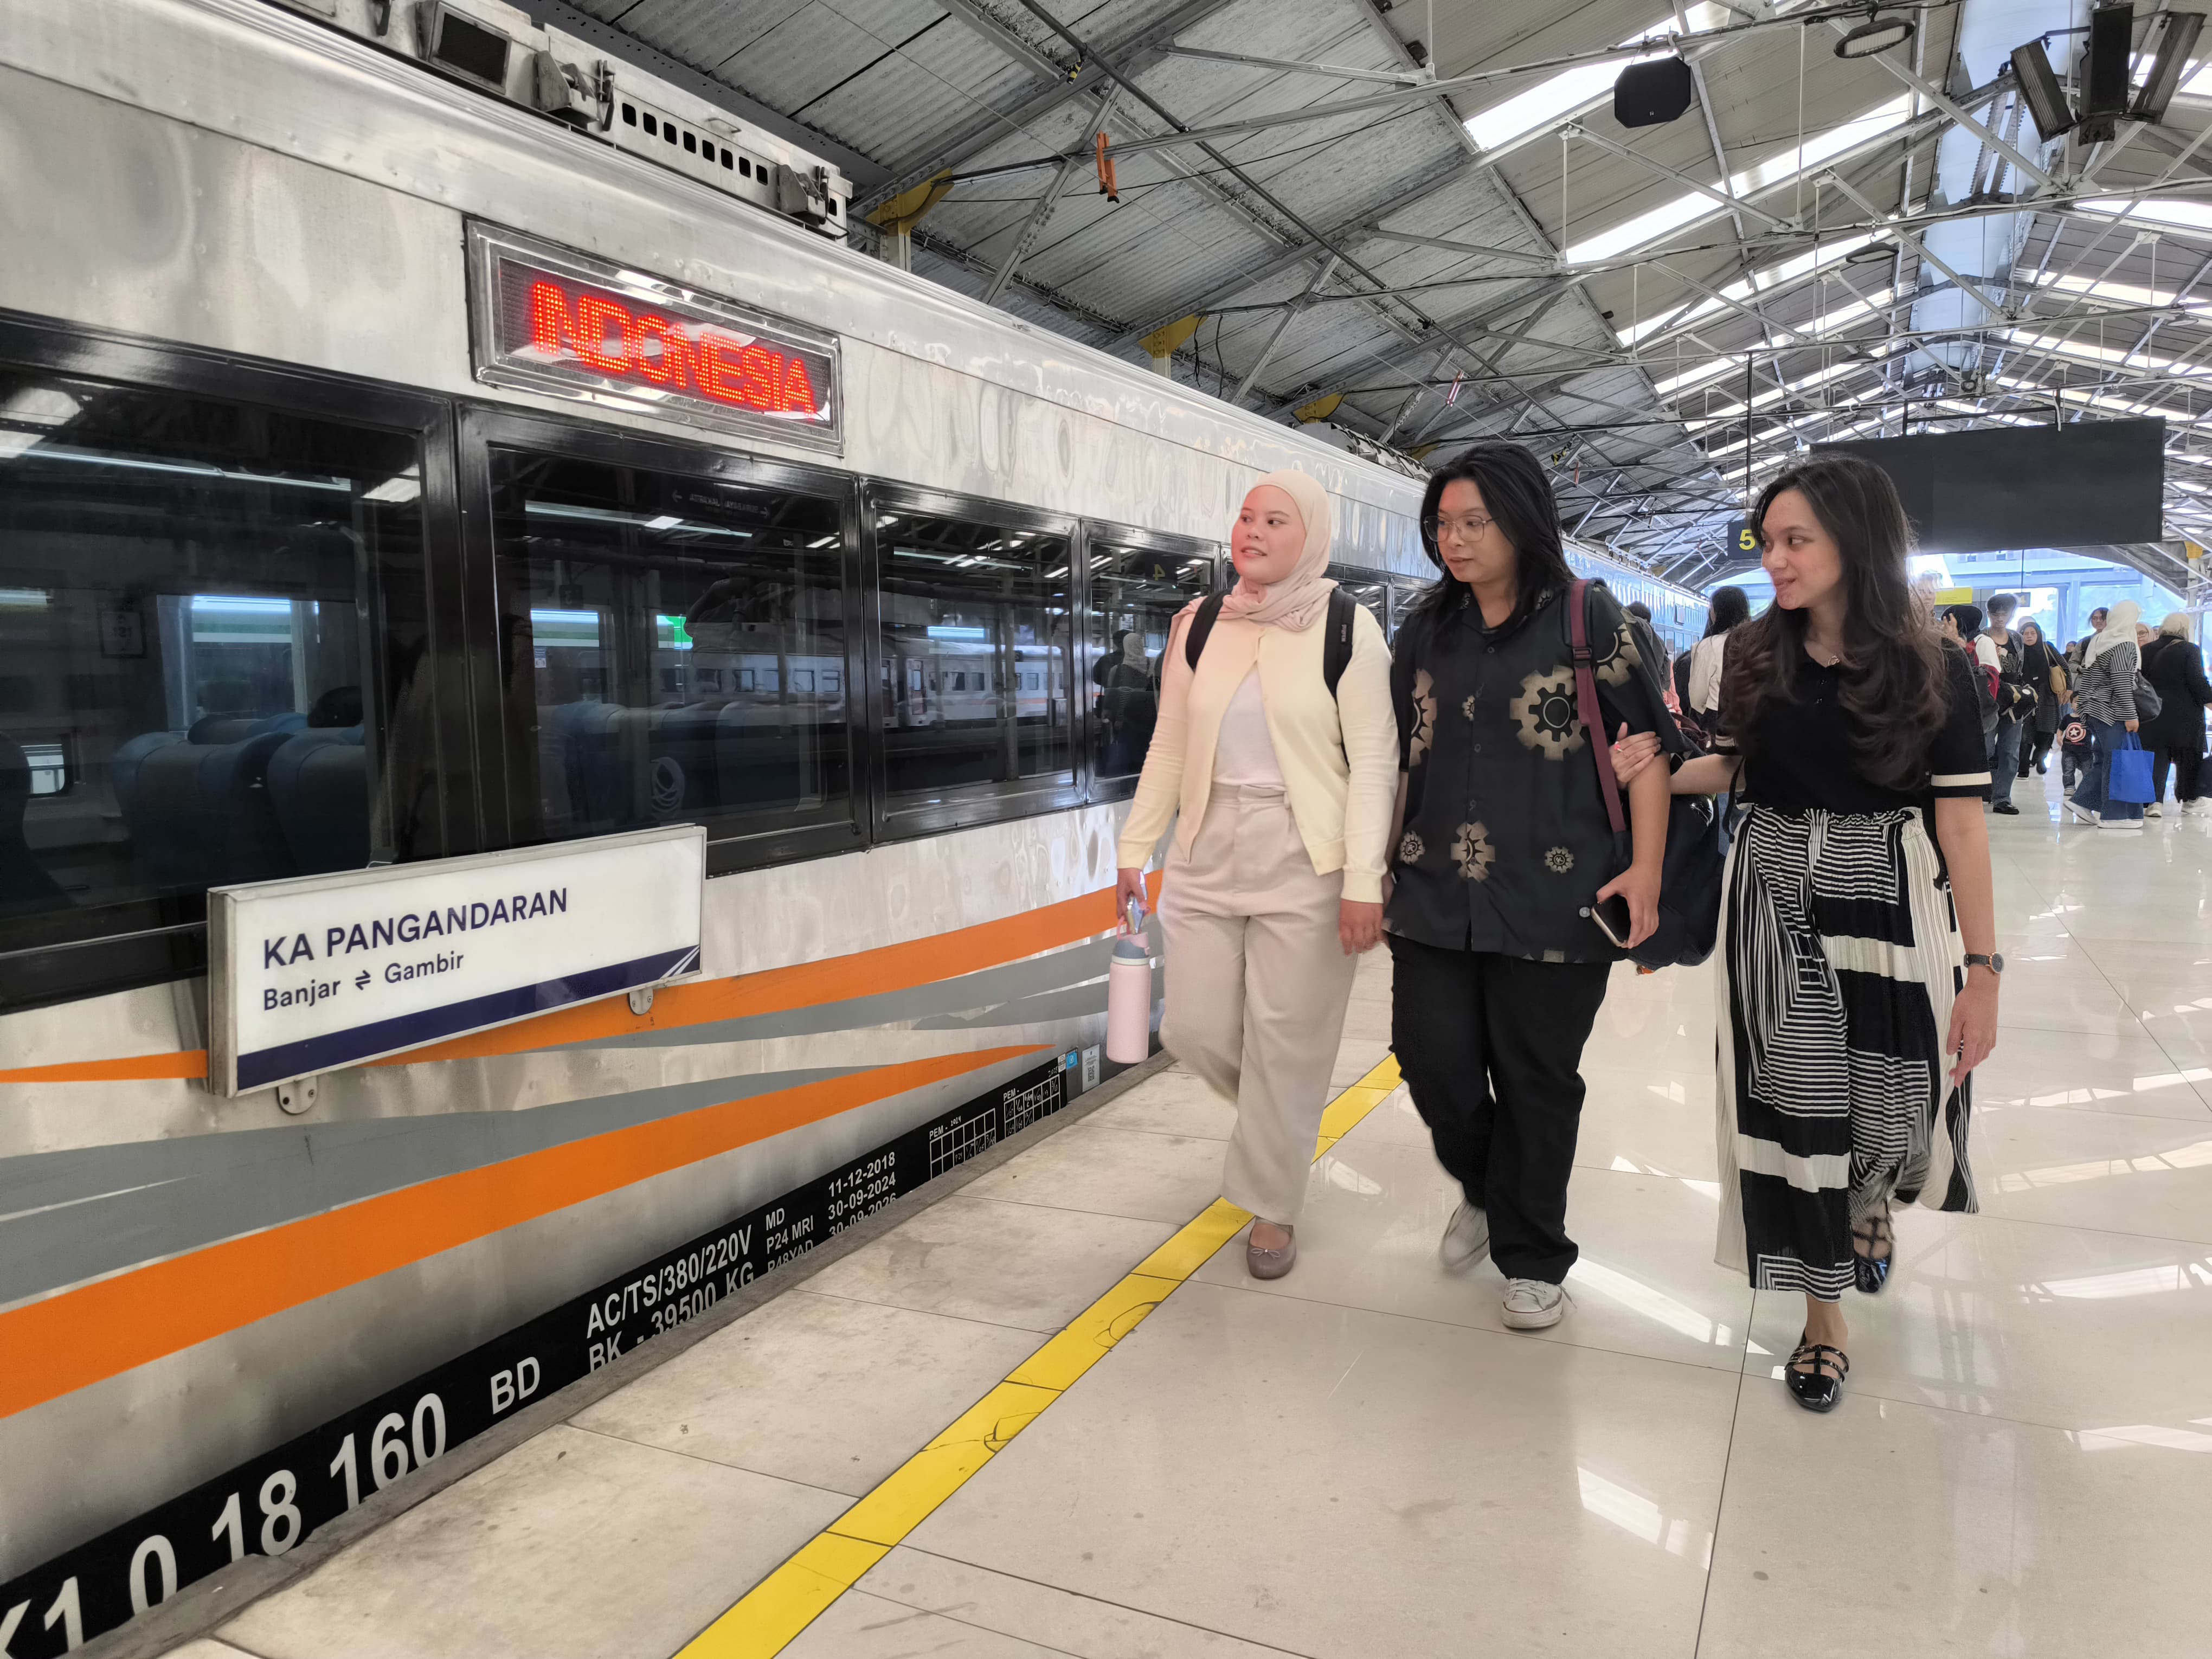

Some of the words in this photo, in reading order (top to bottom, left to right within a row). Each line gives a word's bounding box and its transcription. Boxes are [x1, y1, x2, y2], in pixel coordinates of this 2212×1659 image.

[533, 281, 814, 417] INDONESIA
[1739, 529, 1756, 550] 5
[263, 933, 314, 969] KA
[326, 888, 567, 958] PANGANDARAN
[263, 978, 341, 1011] Banjar
[384, 950, 465, 983] Gambir
[929, 1125, 943, 1140] PEM
[1003, 1088, 1016, 1101] PEM
[766, 1207, 785, 1231] MD
[828, 1152, 895, 1198] 11-12-2018
[766, 1228, 789, 1255] P24
[792, 1214, 814, 1241] MRI
[828, 1171, 896, 1220] 30-09-2024
[586, 1224, 752, 1339] AC/TS/380/220V
[589, 1330, 622, 1373] BK
[651, 1282, 716, 1336] 39500
[726, 1262, 754, 1296] KG
[129, 1534, 178, 1617] 0
[211, 1469, 302, 1563] 18
[329, 1393, 447, 1511] 160
[490, 1356, 541, 1415] BD
